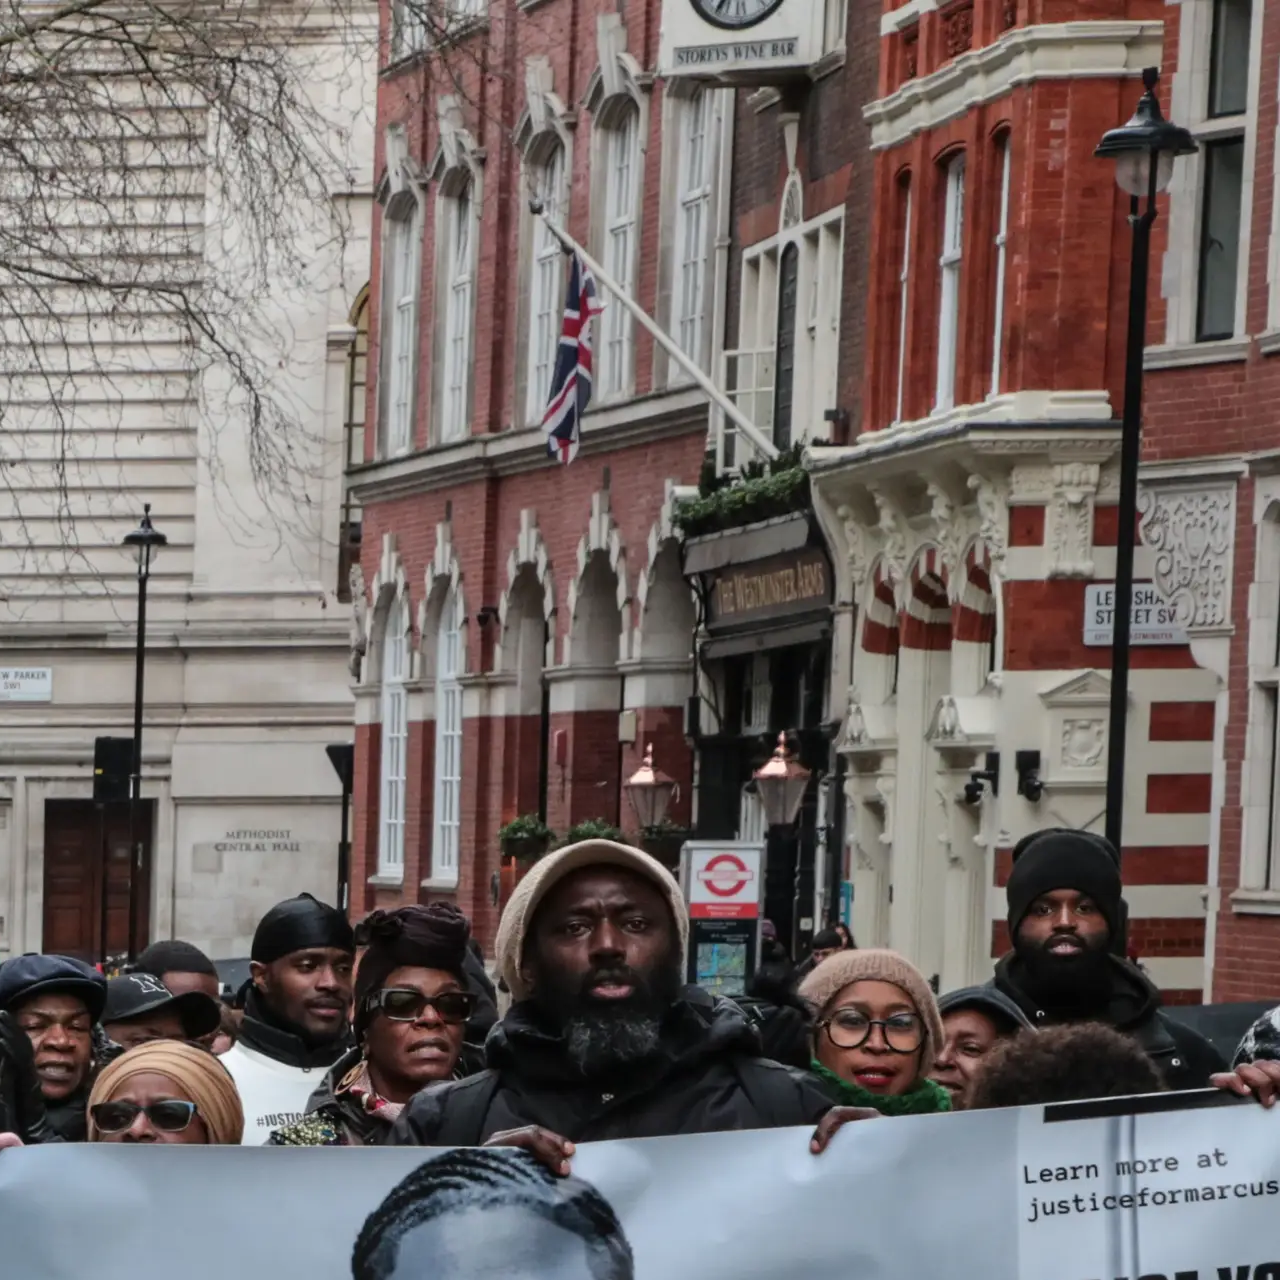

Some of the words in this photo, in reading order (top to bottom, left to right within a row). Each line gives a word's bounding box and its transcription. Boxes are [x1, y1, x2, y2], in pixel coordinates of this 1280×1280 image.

[677, 47, 728, 64] STOREYS
[733, 45, 766, 60] WINE
[771, 42, 796, 57] BAR
[13, 671, 48, 680] PARKER
[3, 682, 21, 690] SW1
[225, 829, 292, 840] METHODIST
[214, 842, 267, 853] CENTRAL
[272, 842, 301, 853] HALL
[1024, 1163, 1099, 1185] Learn
[1115, 1155, 1180, 1177] more
[1196, 1148, 1229, 1169] at
[1027, 1178, 1280, 1223] justiceformarcus
